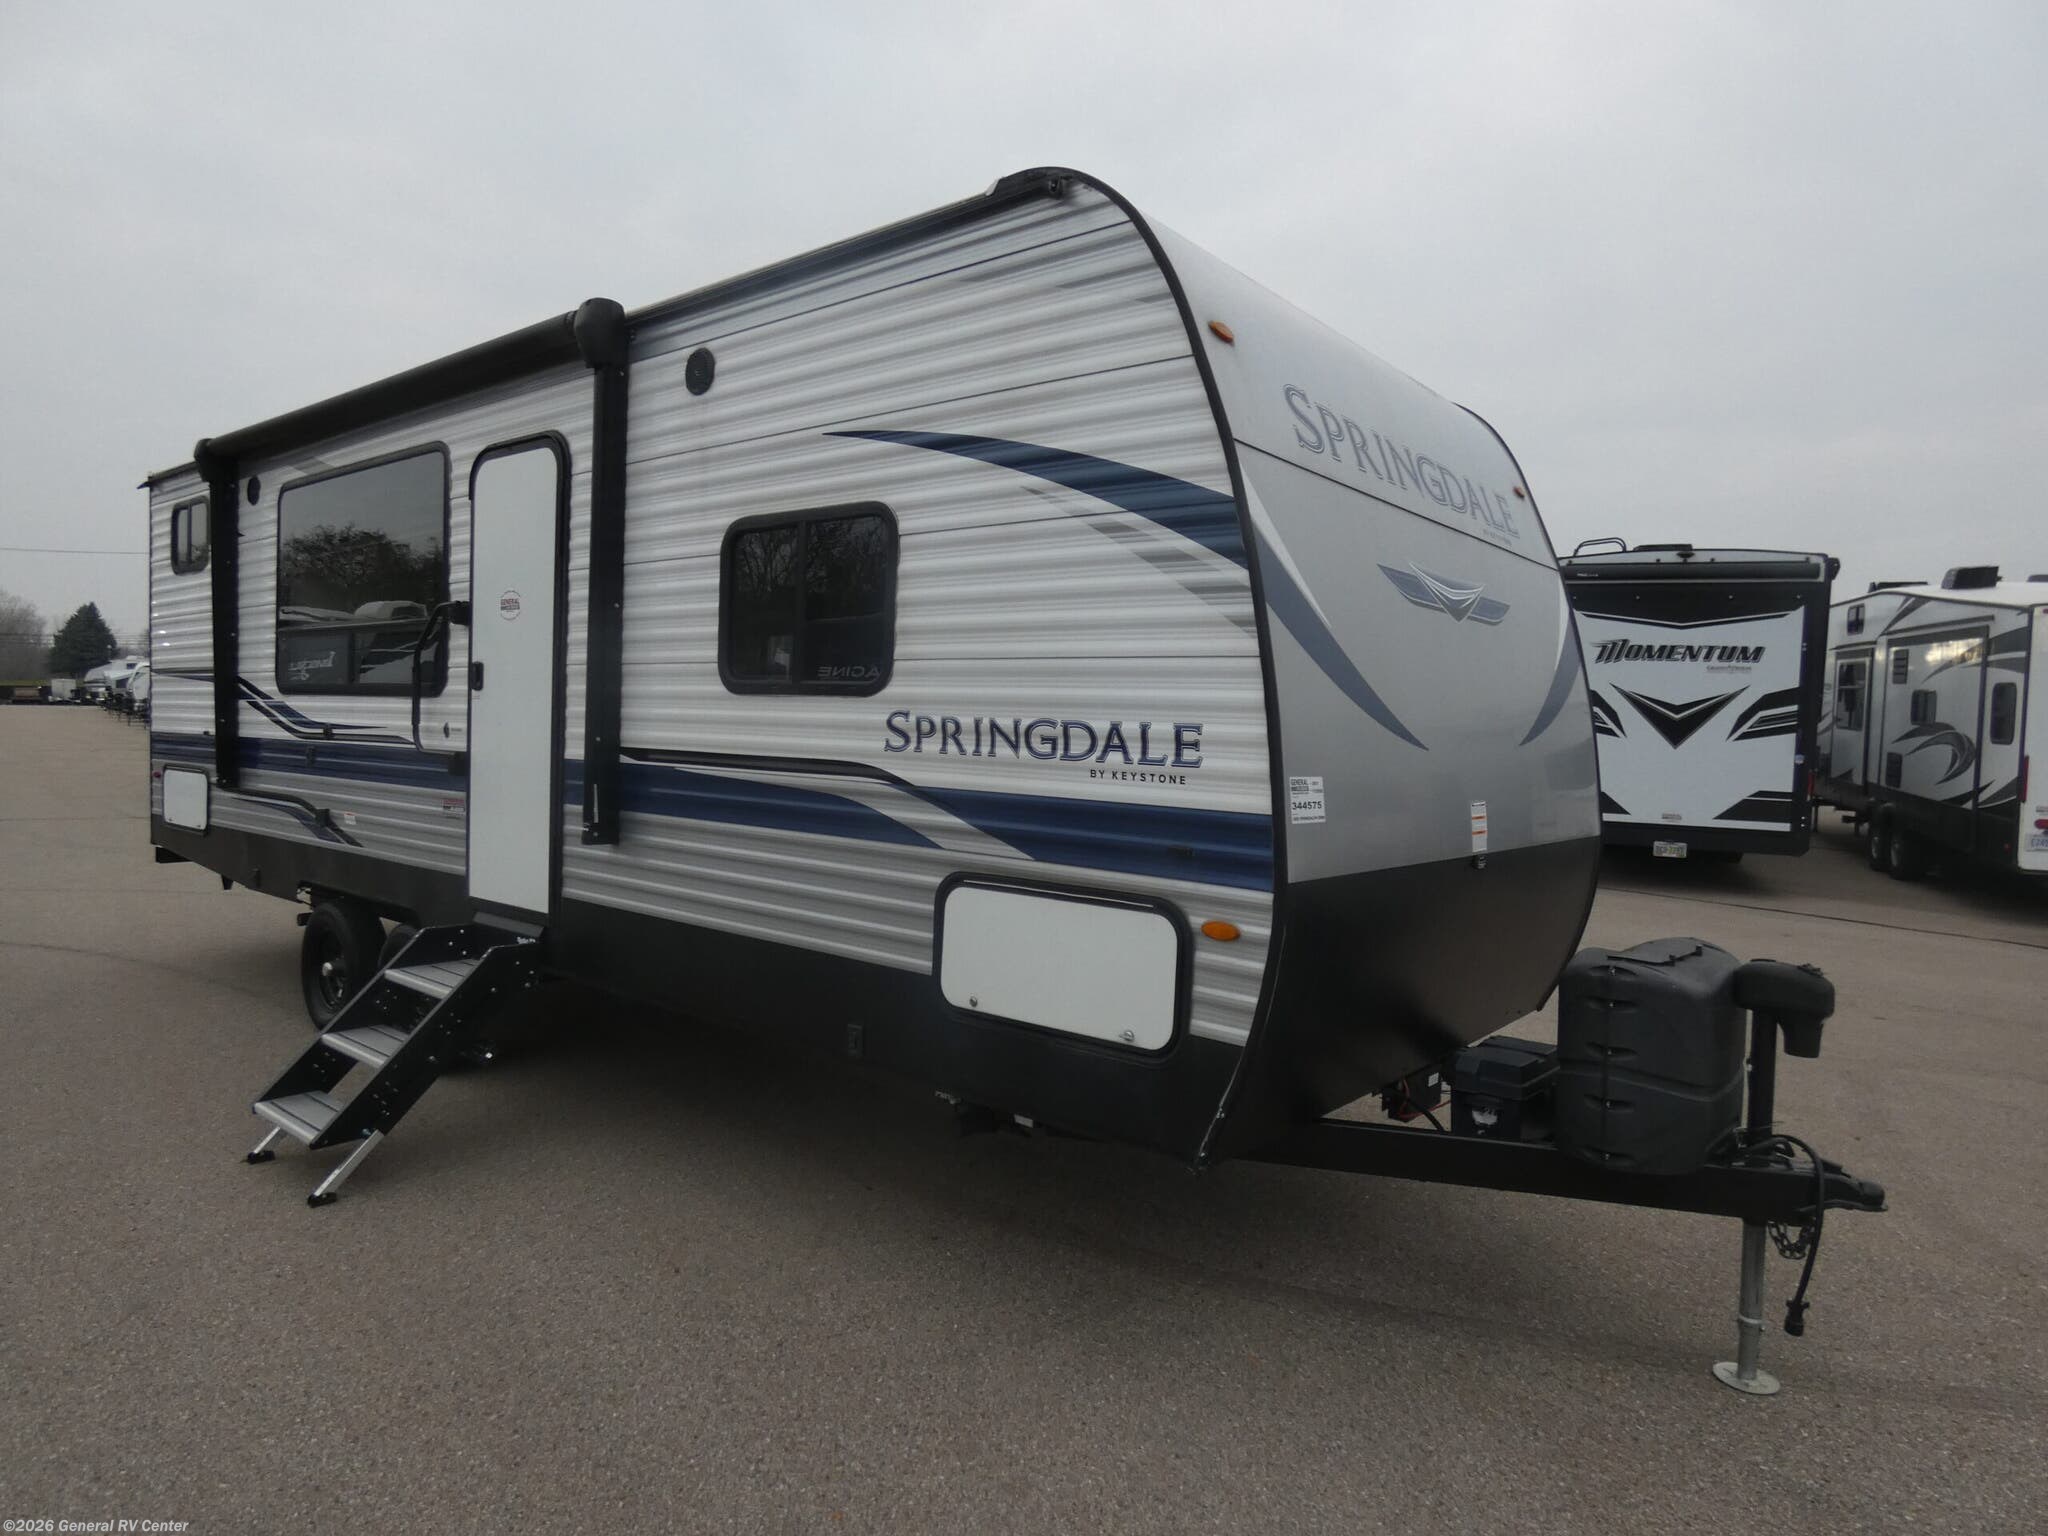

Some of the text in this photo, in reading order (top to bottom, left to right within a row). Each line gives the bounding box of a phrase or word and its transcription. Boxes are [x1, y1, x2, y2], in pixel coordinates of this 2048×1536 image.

[1282, 383, 1521, 539] SPRINGDALE
[1592, 639, 1767, 664] MOMENTUM
[883, 710, 1204, 769] SPRINGDALE
[1090, 769, 1187, 785] BY KEYSTONE
[1292, 801, 1322, 810] 344575
